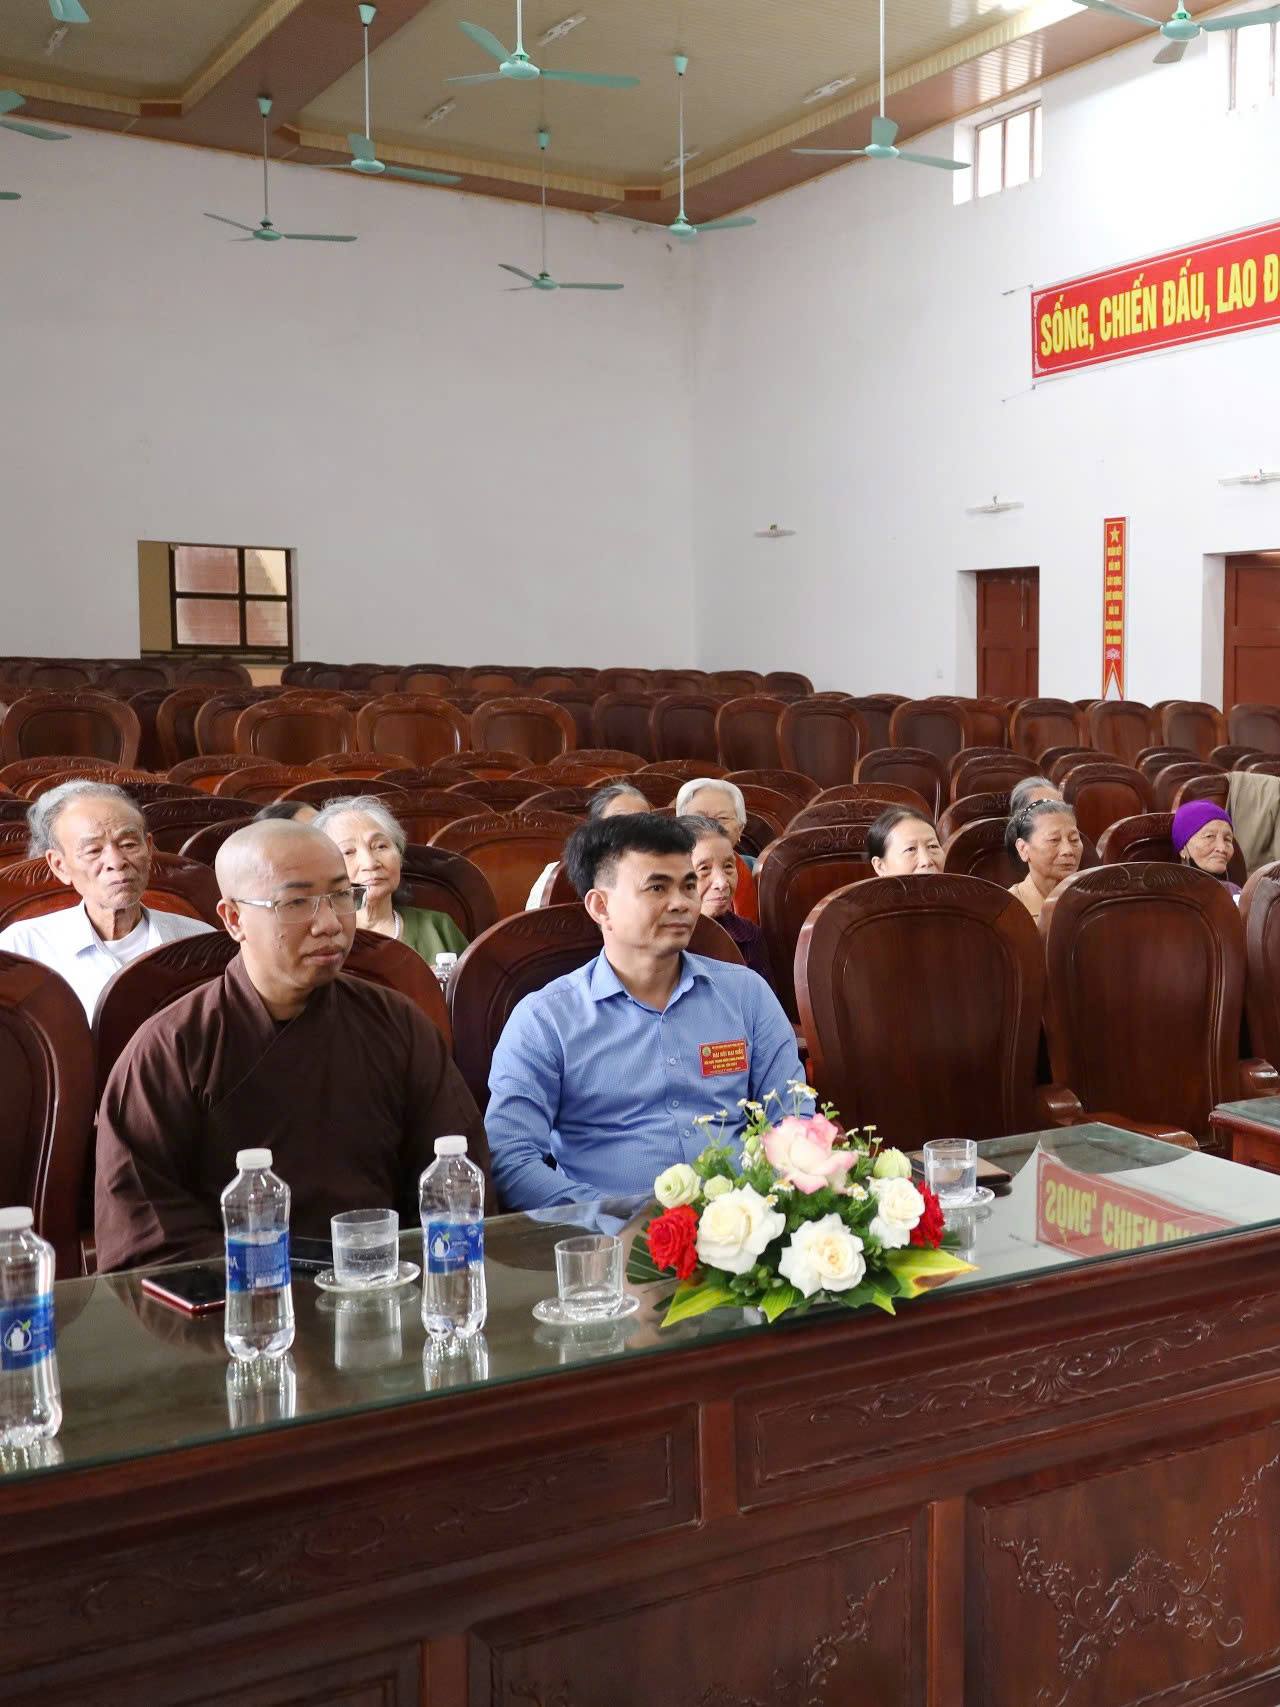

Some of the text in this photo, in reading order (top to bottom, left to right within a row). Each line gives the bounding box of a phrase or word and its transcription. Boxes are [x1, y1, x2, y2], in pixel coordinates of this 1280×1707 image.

[1040, 294, 1094, 356] SỐNG,
[1099, 274, 1157, 341] CHIẾN
[1162, 259, 1210, 326] ĐẤU,
[1216, 258, 1257, 314] LAO
